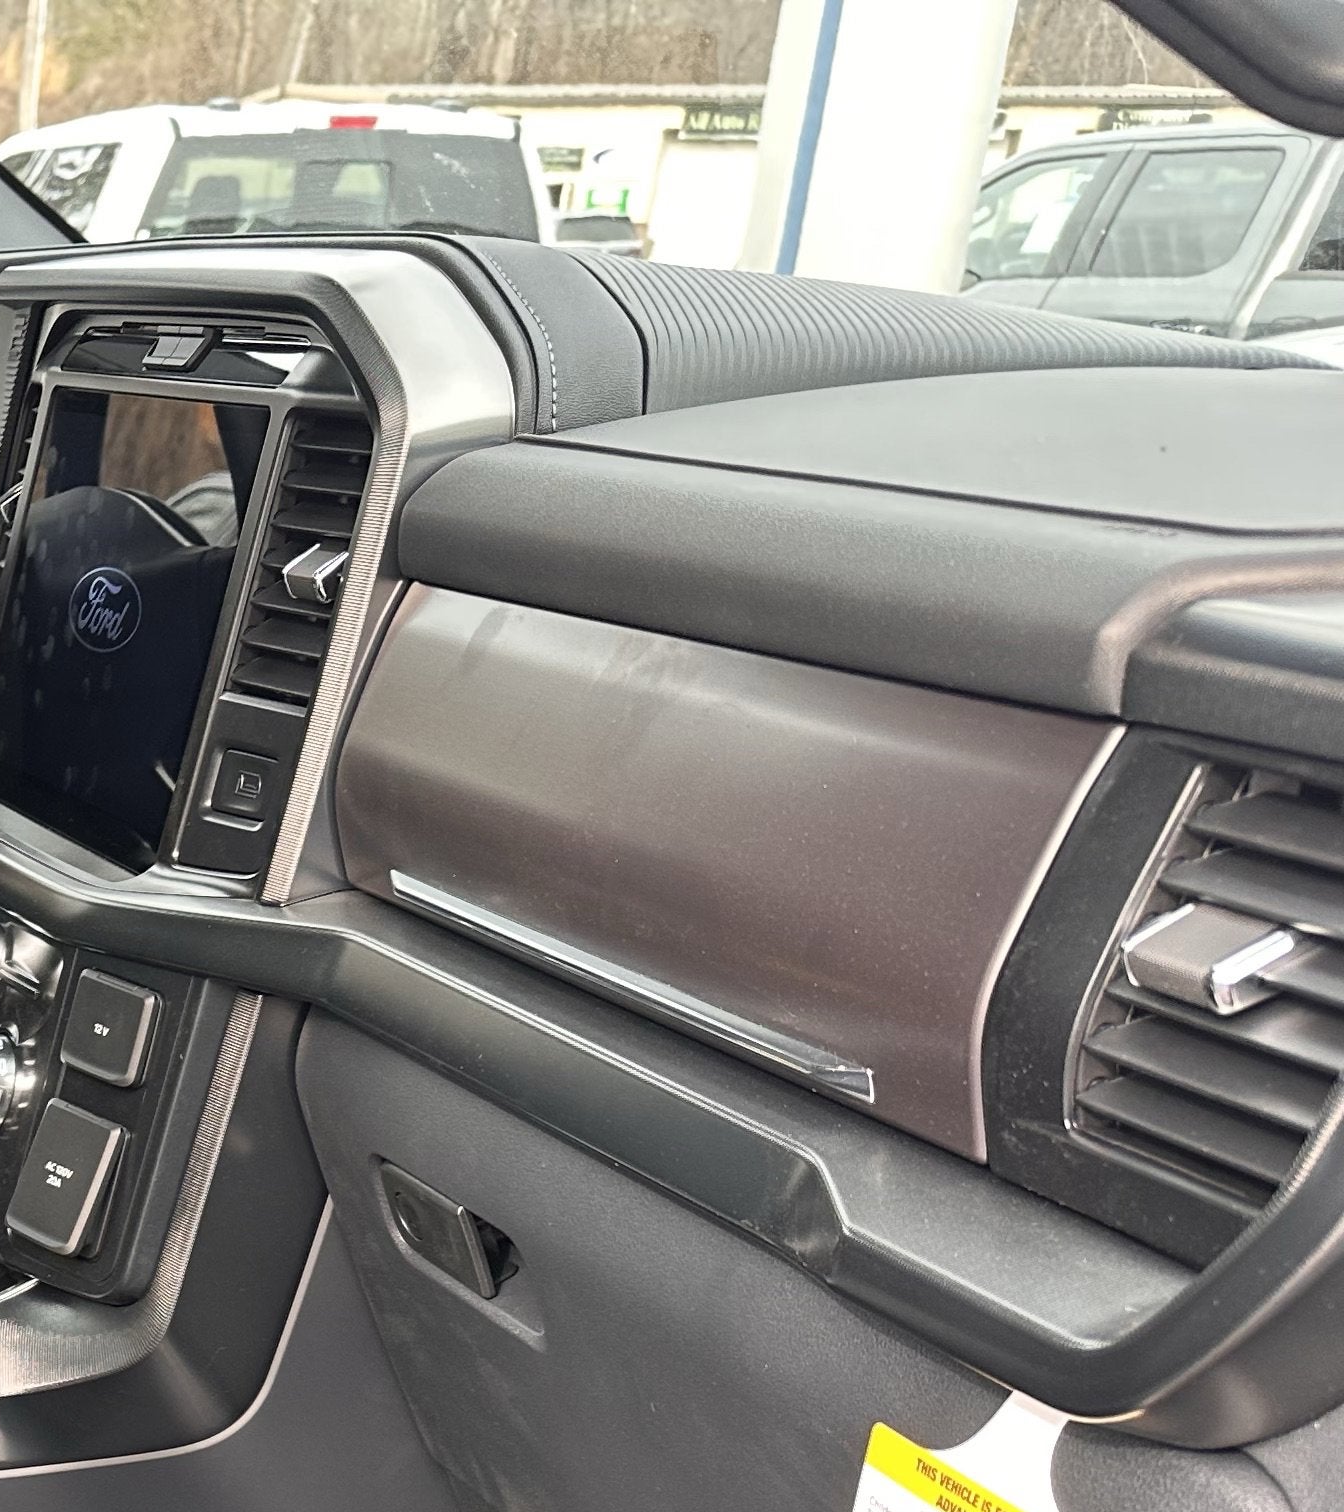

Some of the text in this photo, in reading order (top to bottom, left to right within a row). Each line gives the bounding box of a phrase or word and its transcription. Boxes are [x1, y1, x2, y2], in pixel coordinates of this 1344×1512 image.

[78, 576, 130, 641] Ford
[916, 1457, 938, 1482] THIS
[939, 1472, 980, 1508] VEHICLE
